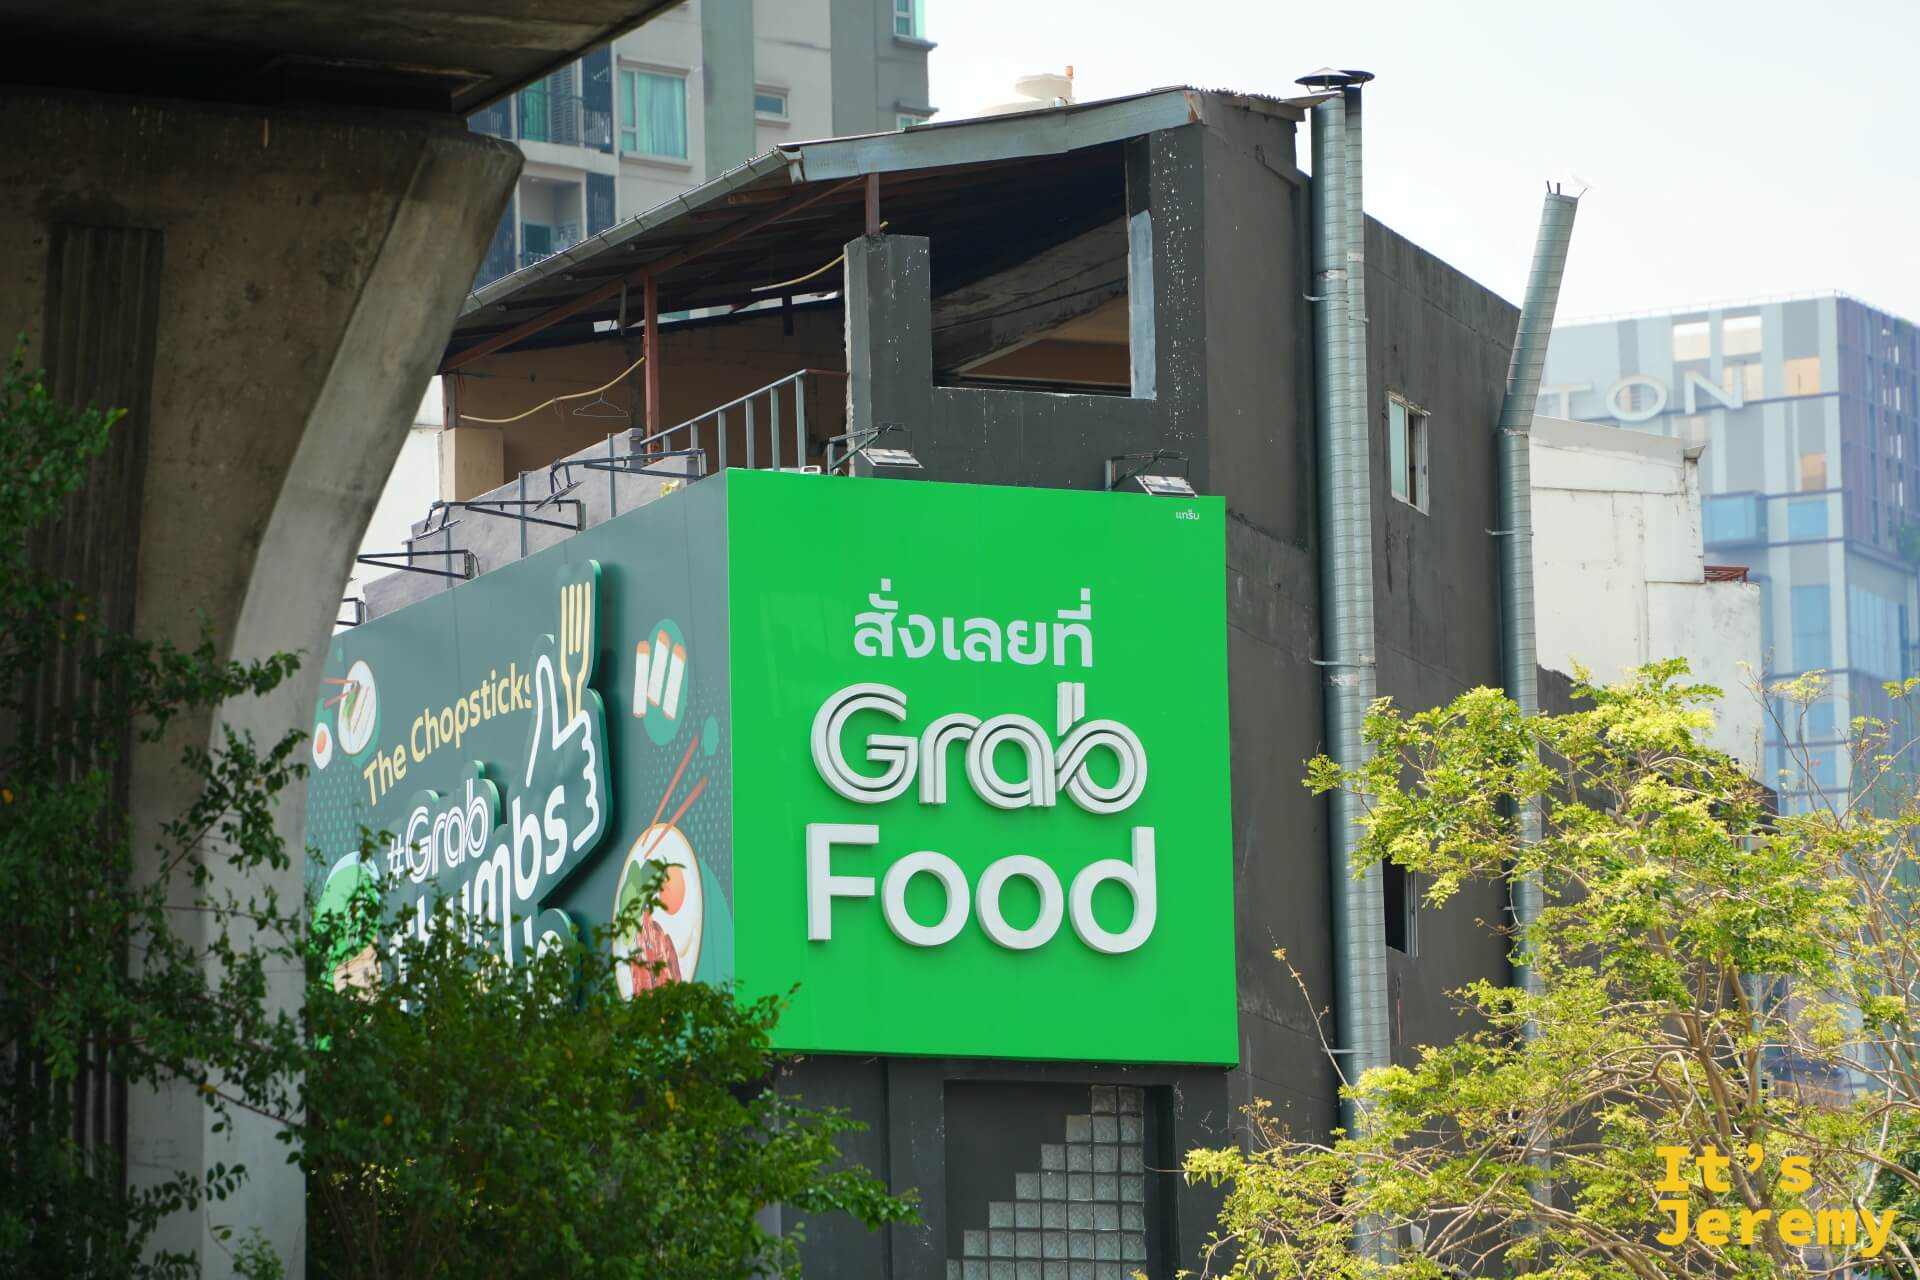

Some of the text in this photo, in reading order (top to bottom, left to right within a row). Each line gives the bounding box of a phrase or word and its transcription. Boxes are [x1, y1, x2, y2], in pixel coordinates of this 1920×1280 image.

[853, 577, 1094, 668] สั่งเลยที่
[363, 750, 407, 807] The
[810, 681, 1148, 815] Grab
[387, 778, 489, 891] #Grab
[806, 823, 1157, 954] Food
